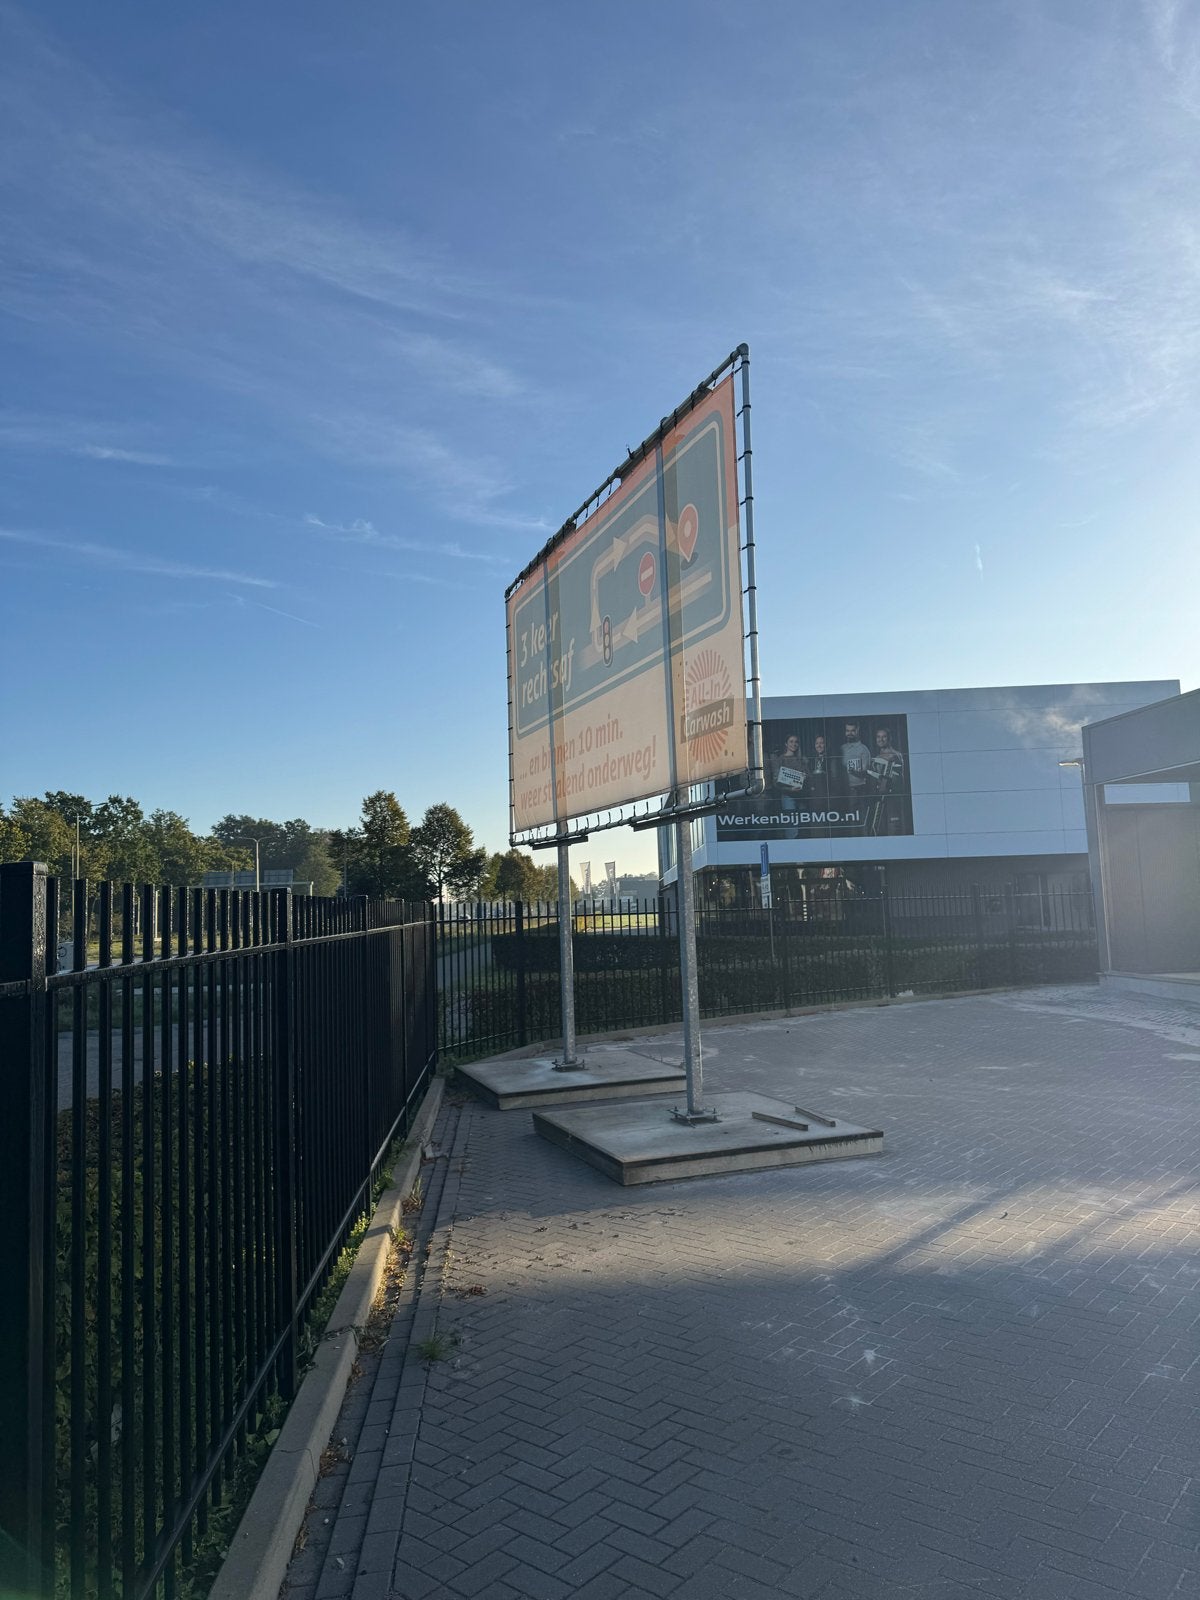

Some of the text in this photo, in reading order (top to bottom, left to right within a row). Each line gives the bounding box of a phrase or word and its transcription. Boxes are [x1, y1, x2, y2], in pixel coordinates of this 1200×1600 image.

[521, 631, 528, 668] 3
[522, 638, 575, 708] rechsaf
[520, 734, 657, 810] weer stalend onderweg!
[529, 757, 540, 776] en
[579, 725, 592, 756] 10
[595, 713, 623, 749] min.
[718, 810, 860, 826] WerkenbijBMO.nl
